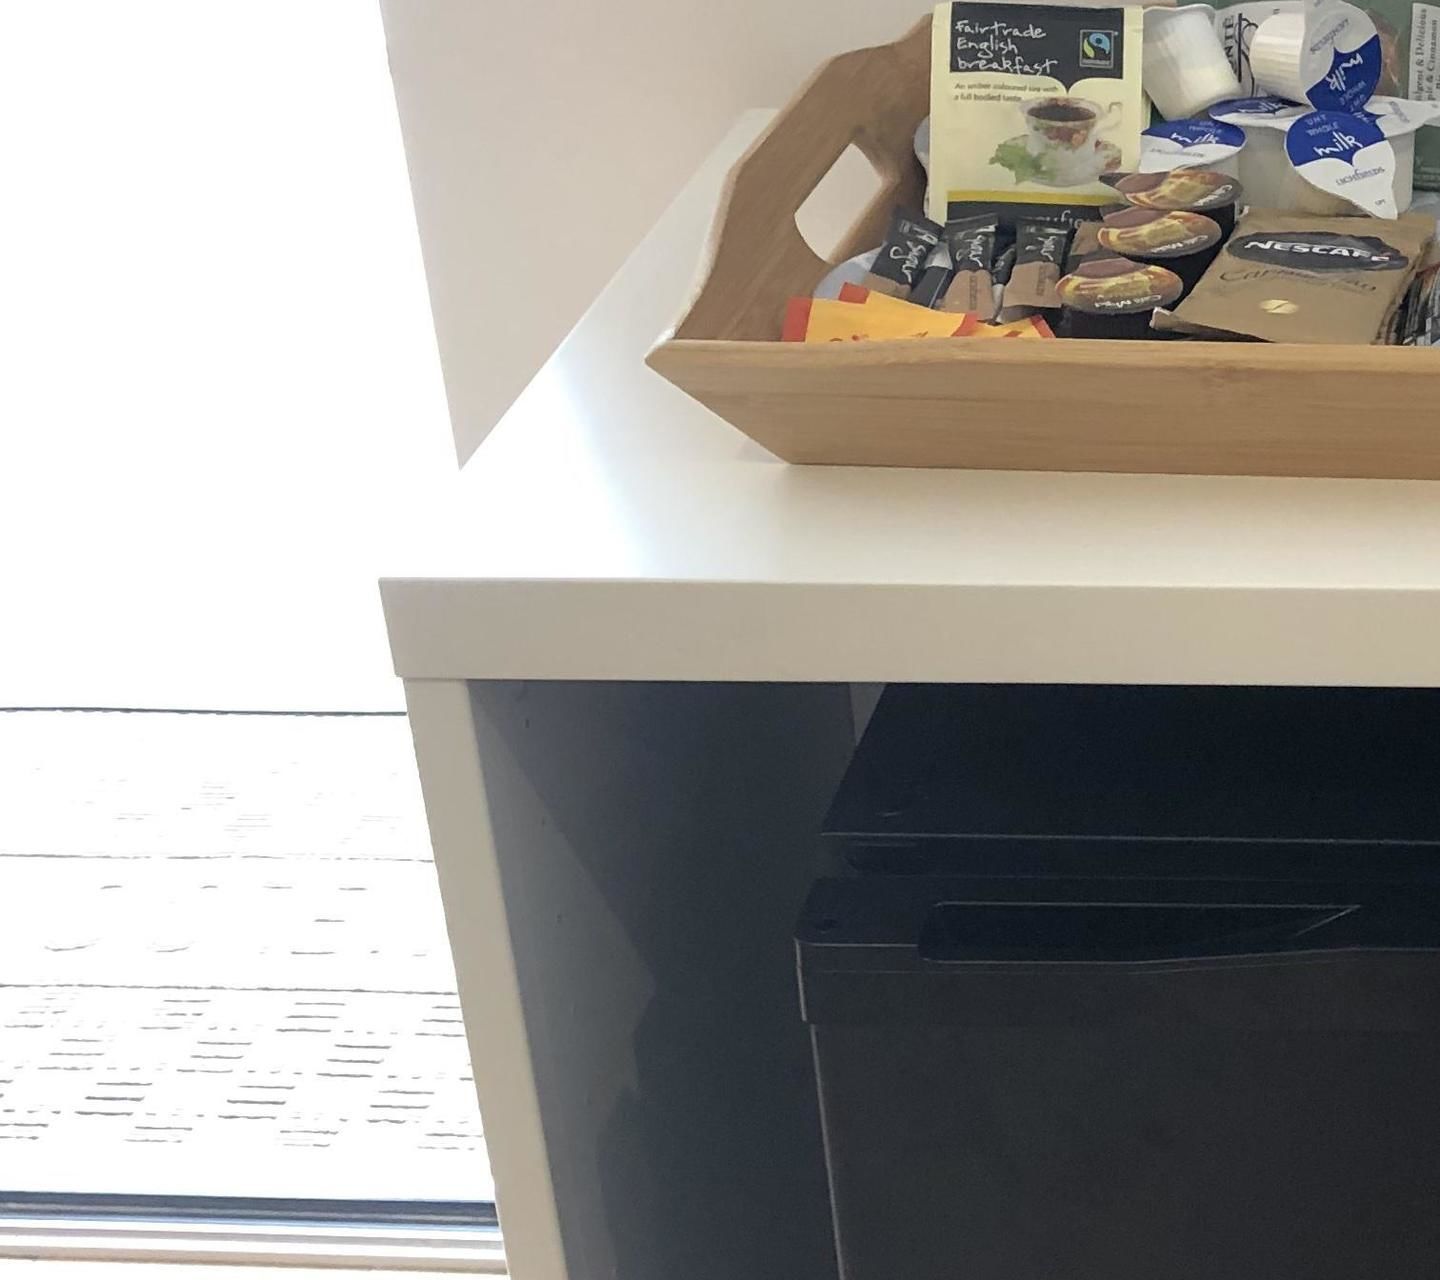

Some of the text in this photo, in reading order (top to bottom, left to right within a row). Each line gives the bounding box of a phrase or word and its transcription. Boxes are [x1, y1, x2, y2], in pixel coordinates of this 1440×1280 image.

[956, 20, 1046, 38] Fairtrade
[1415, 8, 1427, 55] Delicious
[957, 35, 1018, 58] English
[1427, 19, 1438, 71] Cinnamon
[957, 57, 1059, 76] breakfast
[1325, 53, 1363, 92] milk
[1305, 114, 1328, 126] UHT
[1306, 121, 1339, 137] WHOLE
[1170, 132, 1220, 144] milk
[1312, 131, 1363, 157] milk
